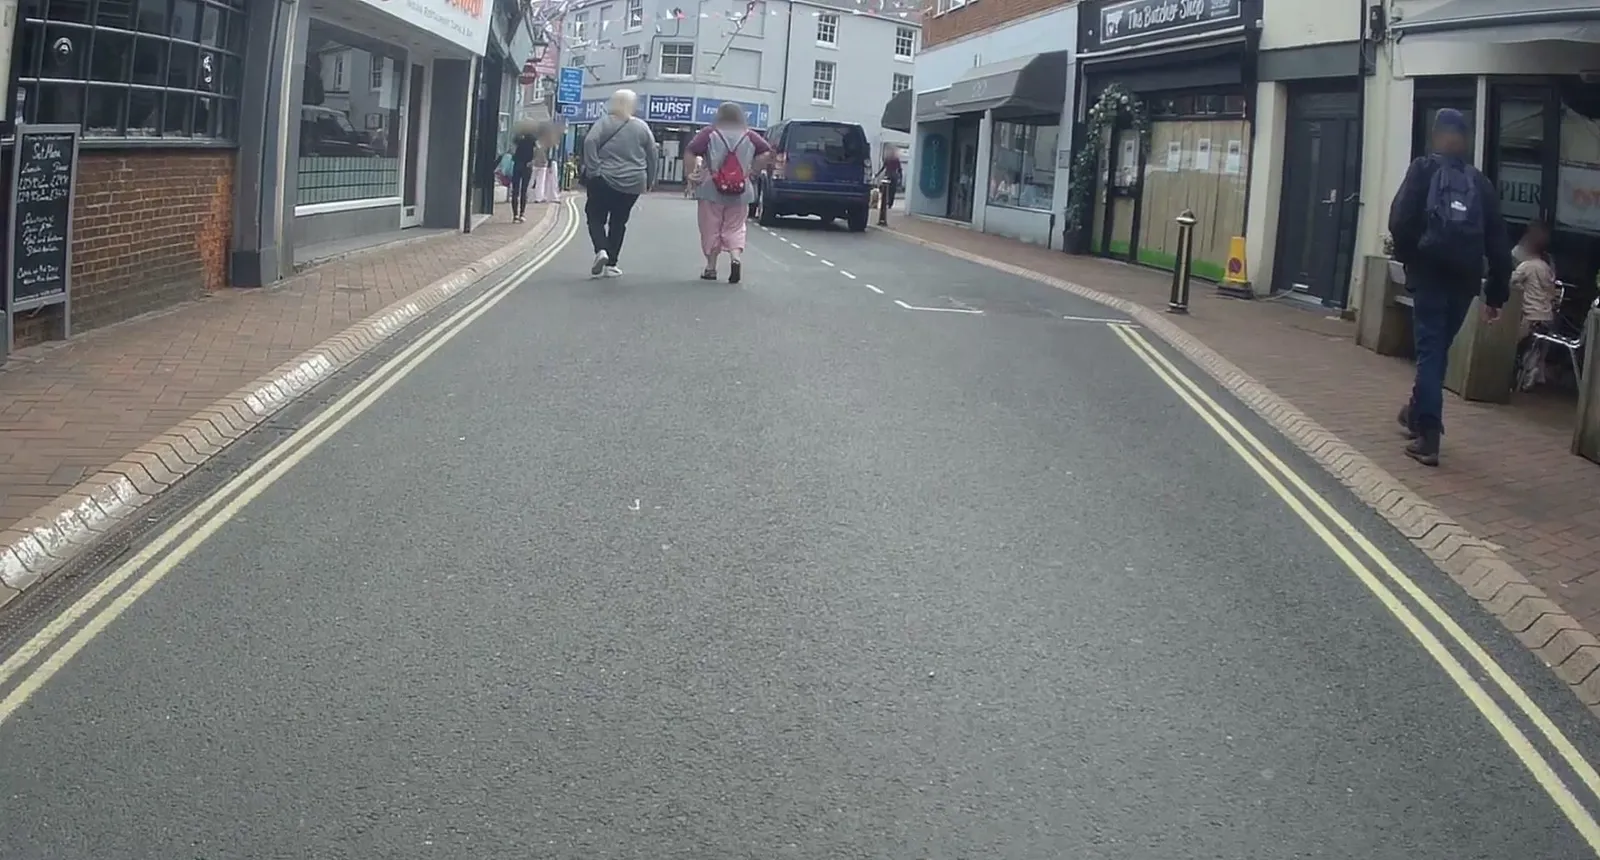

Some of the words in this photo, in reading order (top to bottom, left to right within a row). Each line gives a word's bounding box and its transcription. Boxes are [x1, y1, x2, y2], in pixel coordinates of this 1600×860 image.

[1128, 8, 1143, 29] The
[1144, 1, 1178, 28] Butcher
[1180, 0, 1204, 20] Shop
[651, 102, 692, 115] HURST
